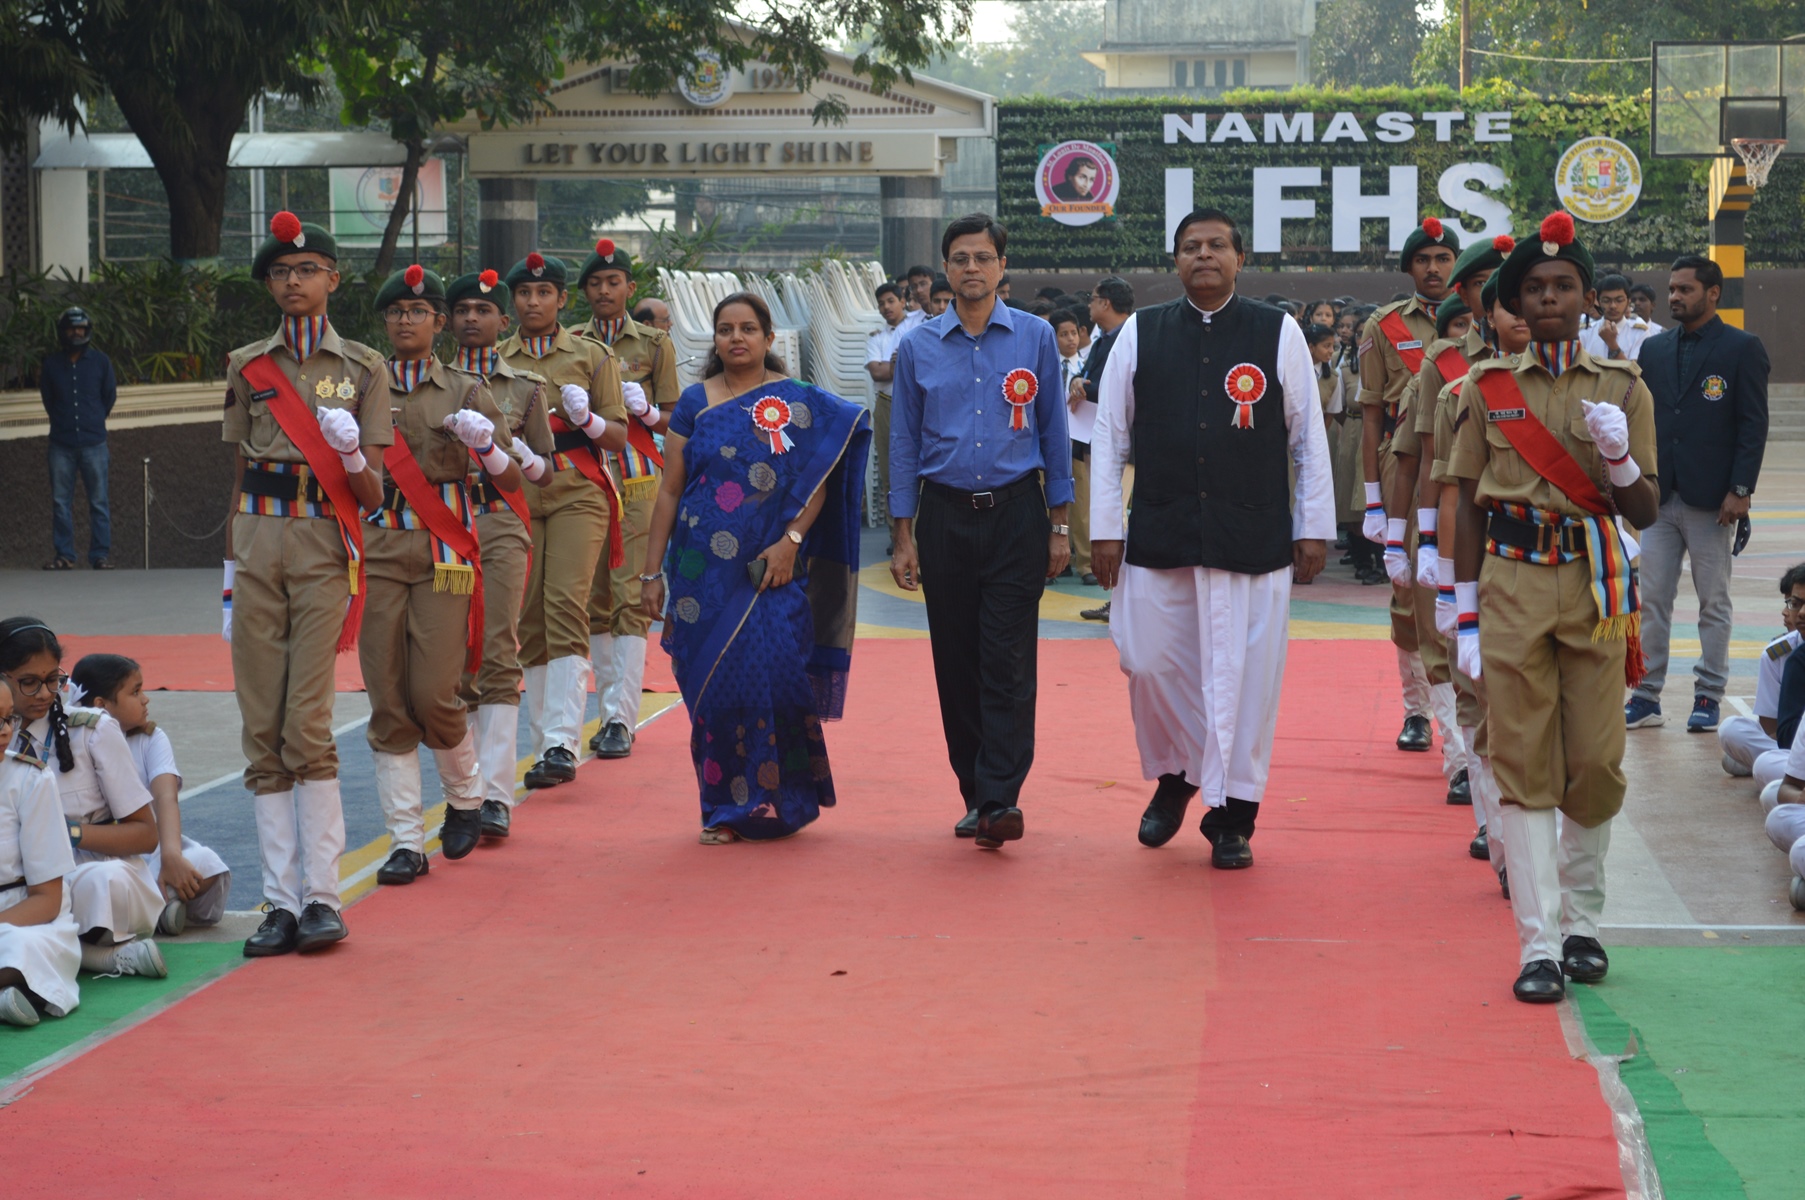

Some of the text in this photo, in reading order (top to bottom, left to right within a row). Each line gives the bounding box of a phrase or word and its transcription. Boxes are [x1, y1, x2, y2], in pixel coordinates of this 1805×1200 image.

[1163, 111, 1512, 144] NAMASTE
[527, 141, 873, 164] LET YOUR LIGHT SHINE
[1558, 157, 1571, 183] LITTLE
[1570, 140, 1603, 156] FLOWER
[1604, 140, 1624, 152] HIGH
[1049, 204, 1107, 212] OUR FOUNDER
